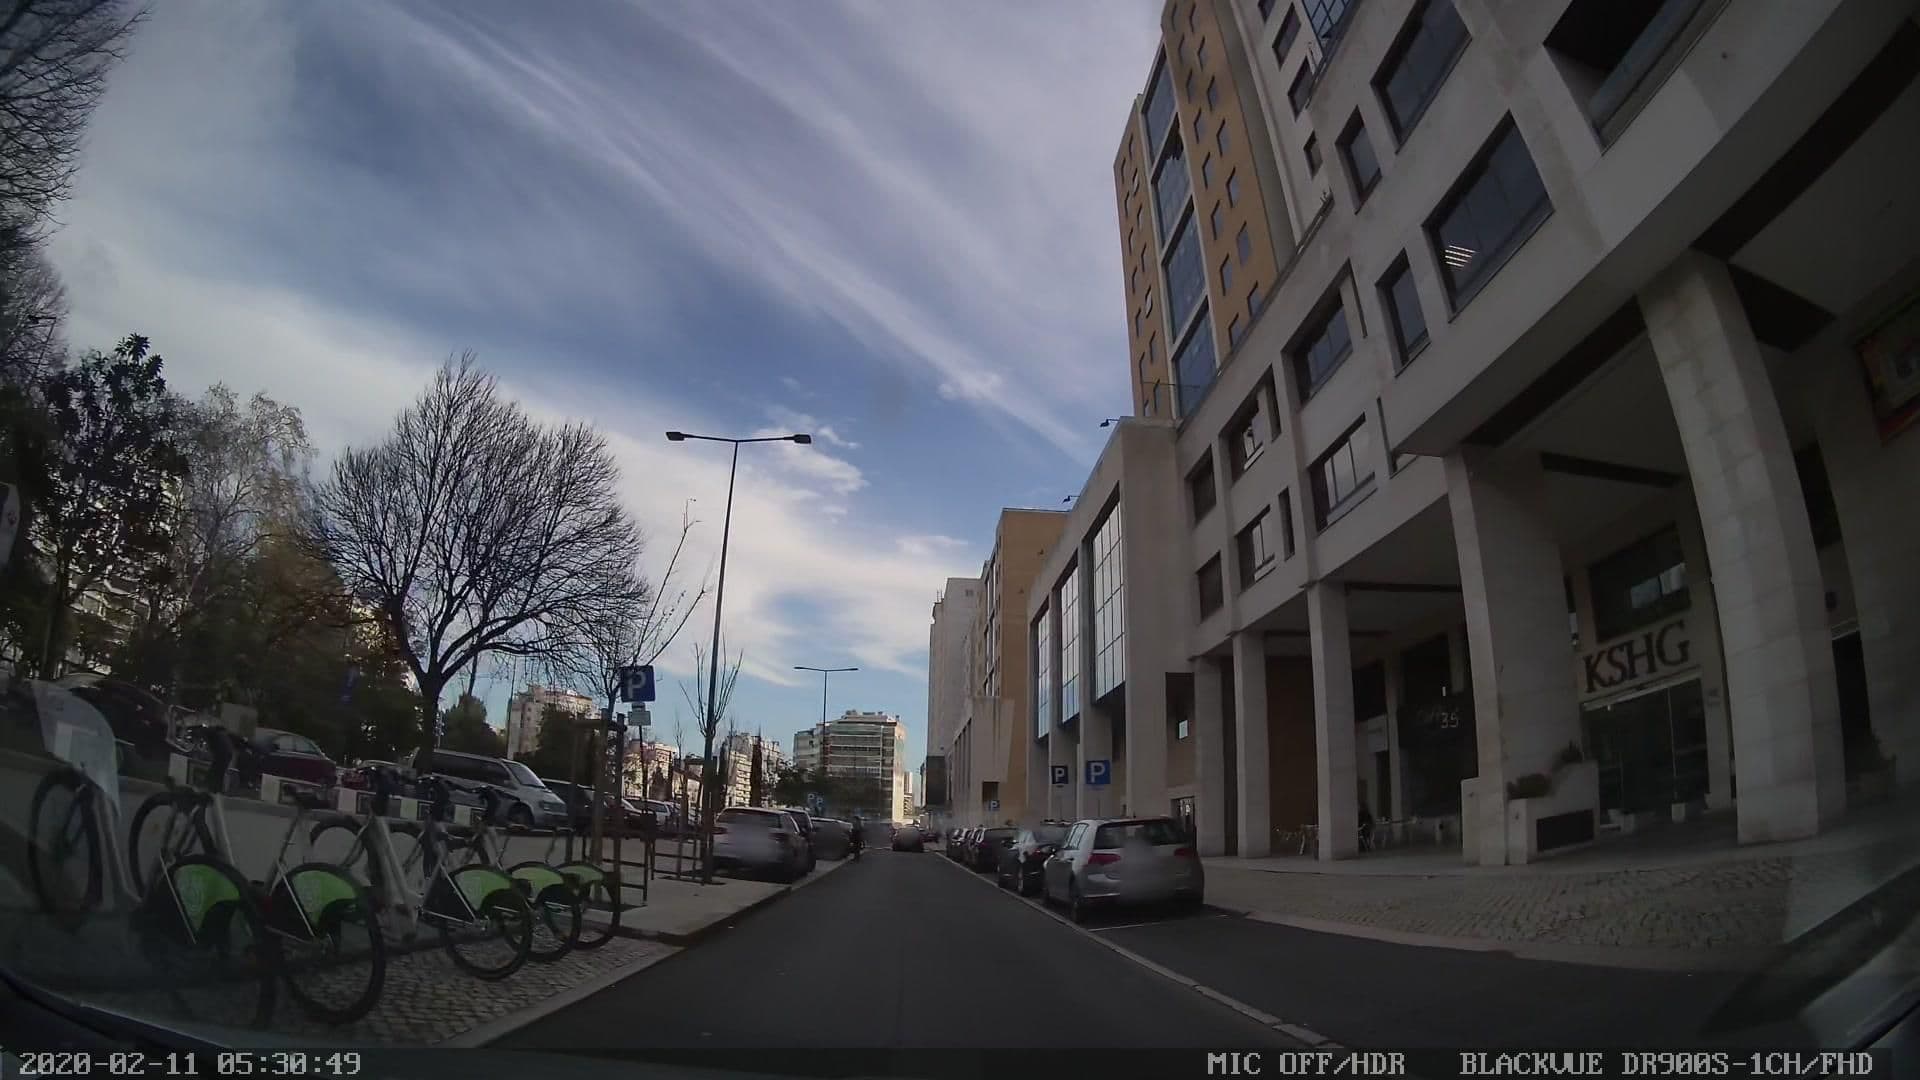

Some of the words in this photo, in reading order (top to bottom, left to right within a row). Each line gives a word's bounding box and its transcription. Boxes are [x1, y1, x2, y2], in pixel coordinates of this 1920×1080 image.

[1583, 619, 1690, 692] KSHG
[627, 671, 647, 699] P
[1055, 768, 1065, 782] P
[1091, 762, 1106, 783] P
